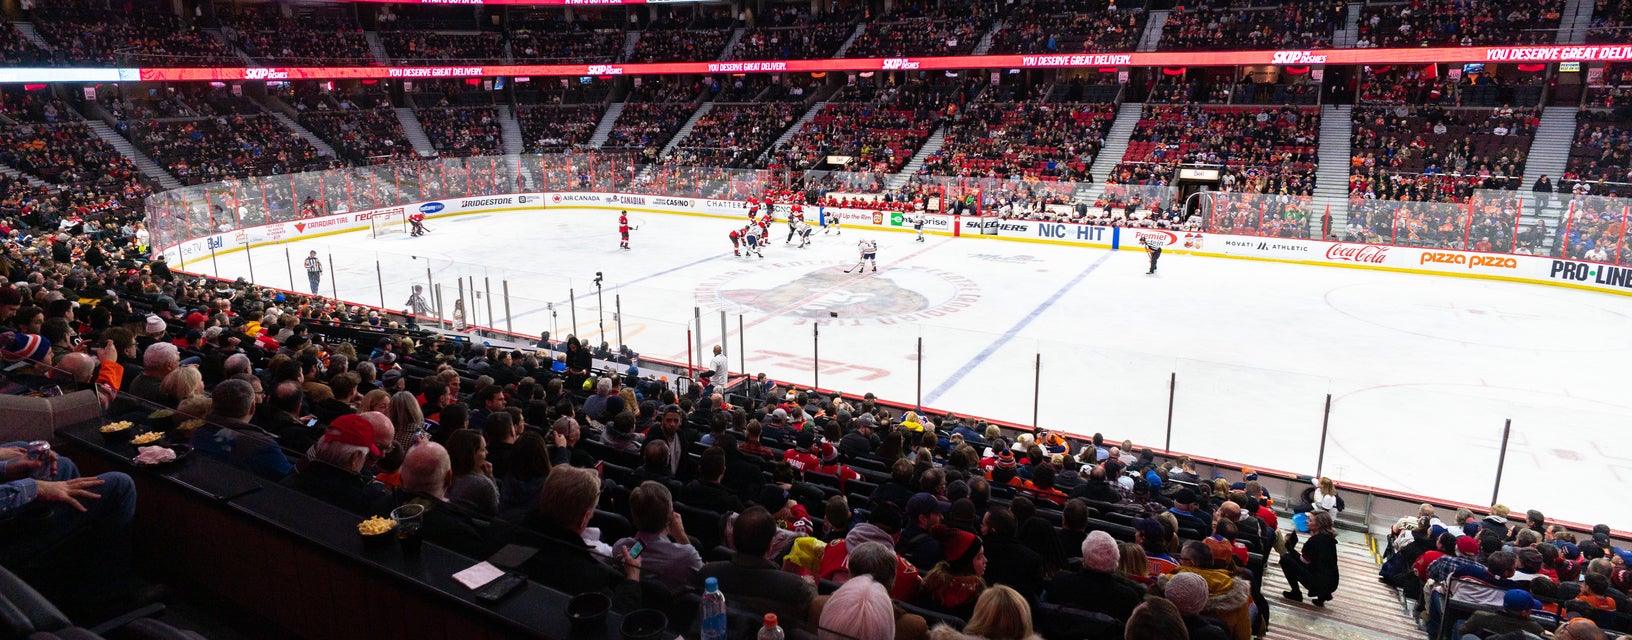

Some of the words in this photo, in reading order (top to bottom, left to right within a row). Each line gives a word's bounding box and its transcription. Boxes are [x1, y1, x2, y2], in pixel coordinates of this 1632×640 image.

[1271, 51, 1302, 64] SKIP
[1301, 55, 1327, 63] DISHES
[1486, 49, 1510, 60] YOU
[1510, 48, 1561, 60] DESERVE
[1560, 47, 1600, 59] GREAT
[882, 58, 902, 69] SKIP
[1022, 56, 1038, 66] YOU
[1038, 56, 1070, 66] DESERVE
[1070, 55, 1093, 65] GREAT
[1094, 54, 1131, 65] DELIVERY.
[389, 68, 402, 77] YOU
[403, 68, 431, 77] DESERVE
[432, 67, 452, 77] GREAT
[452, 67, 483, 76] DELIVERY.
[587, 65, 606, 75] SKIP
[707, 63, 720, 72] YOU
[720, 63, 743, 72] DESERVE
[743, 62, 761, 71] GREAT
[761, 62, 787, 71] DELIVERY.
[245, 68, 269, 80] SKIP
[461, 197, 513, 208] BRIDGESTONE
[620, 196, 646, 205] CANADIAN
[666, 199, 689, 207] CASINO
[706, 200, 742, 209] CHATTER
[307, 218, 336, 229] CANADIAN
[336, 216, 348, 225] TIRE
[1038, 222, 1066, 239] NIC
[1076, 225, 1105, 241] HIT
[1135, 231, 1167, 241] Premier
[207, 235, 223, 250] Bell
[1225, 240, 1253, 248] MOVATI
[1272, 244, 1308, 252] ATHLETIC
[1420, 251, 1467, 265] pizza
[1468, 254, 1517, 269] pizza
